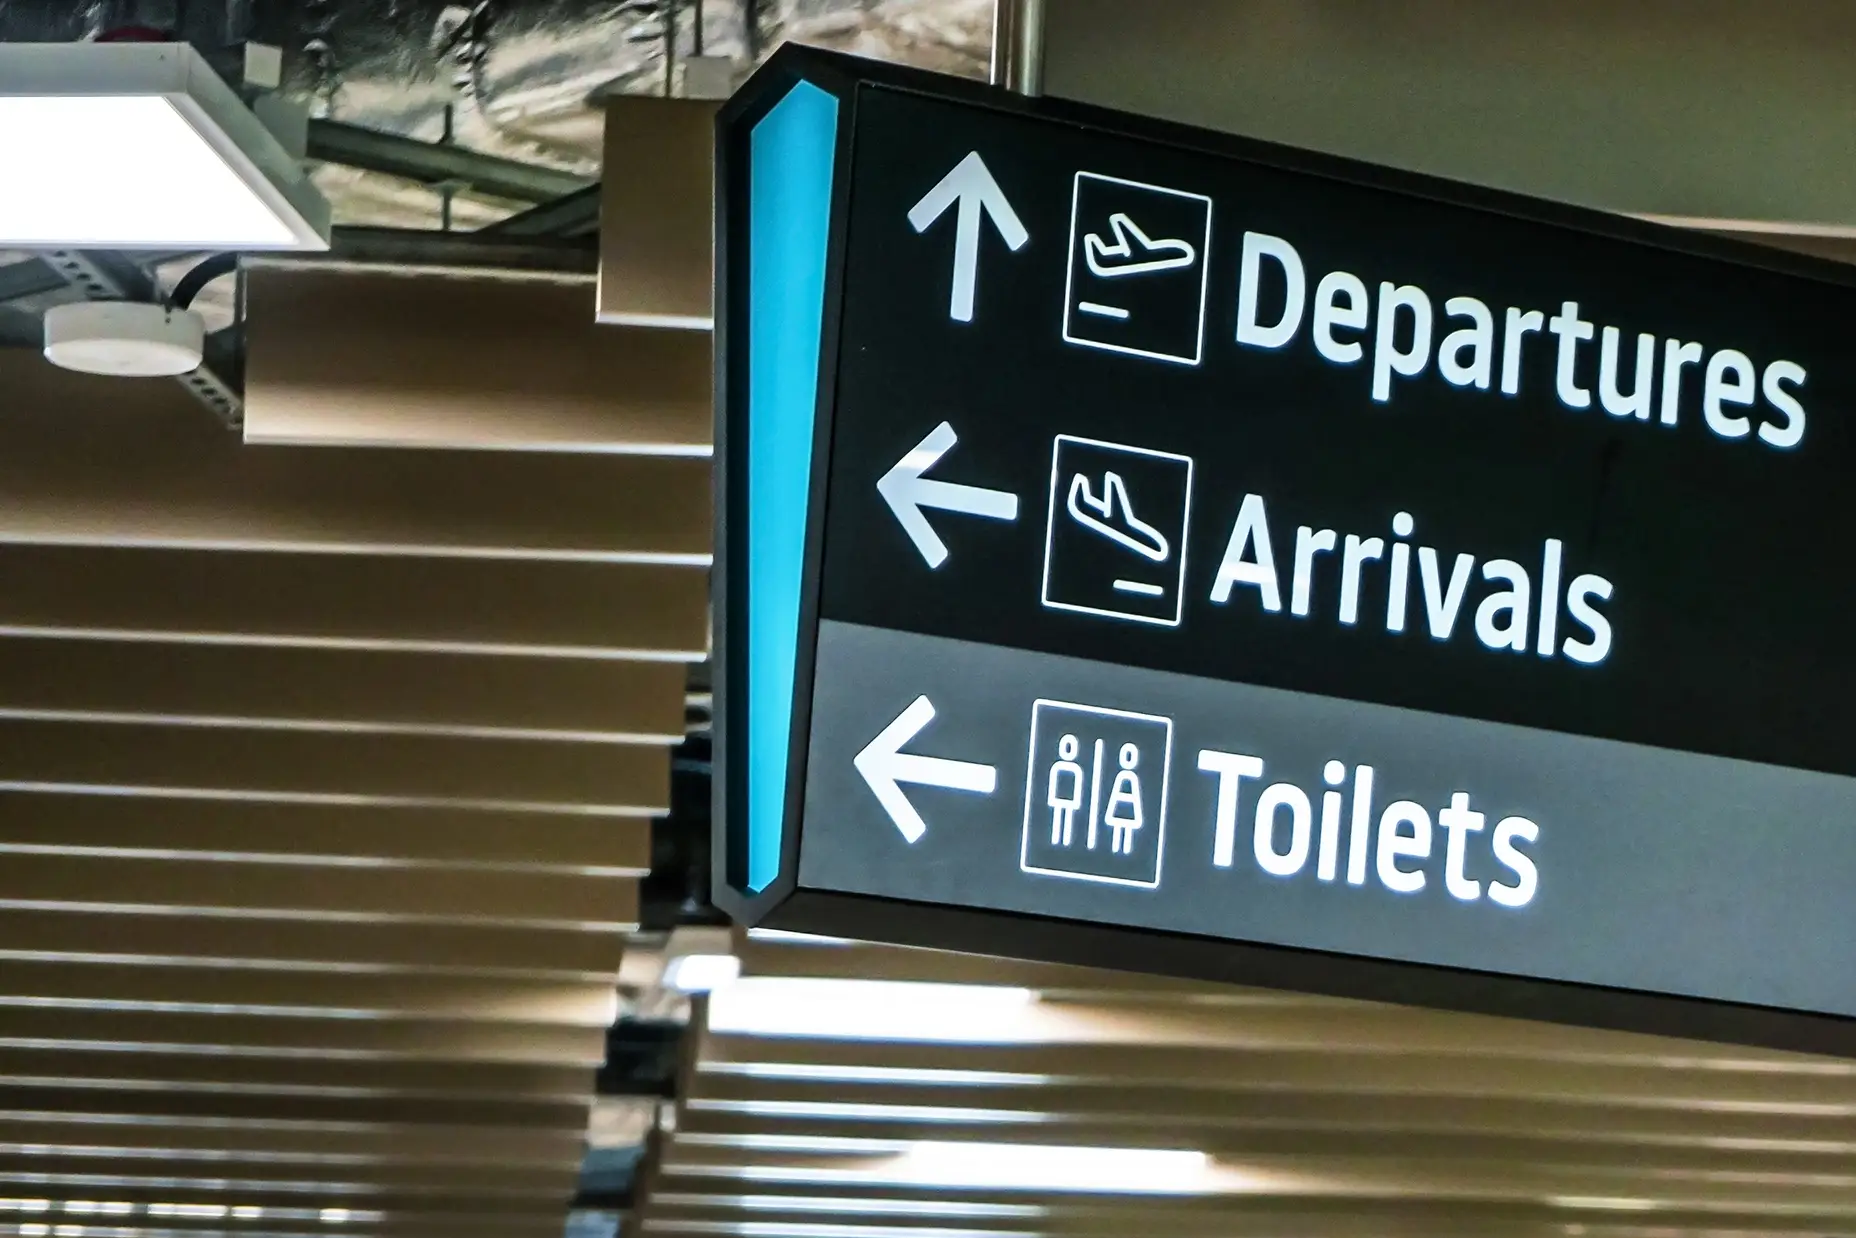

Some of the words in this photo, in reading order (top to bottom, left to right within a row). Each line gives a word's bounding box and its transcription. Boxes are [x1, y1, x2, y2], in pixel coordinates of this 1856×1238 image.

[1235, 230, 1808, 449] Departures
[1208, 492, 1615, 665] Arrivals
[1196, 748, 1542, 910] Toilets
